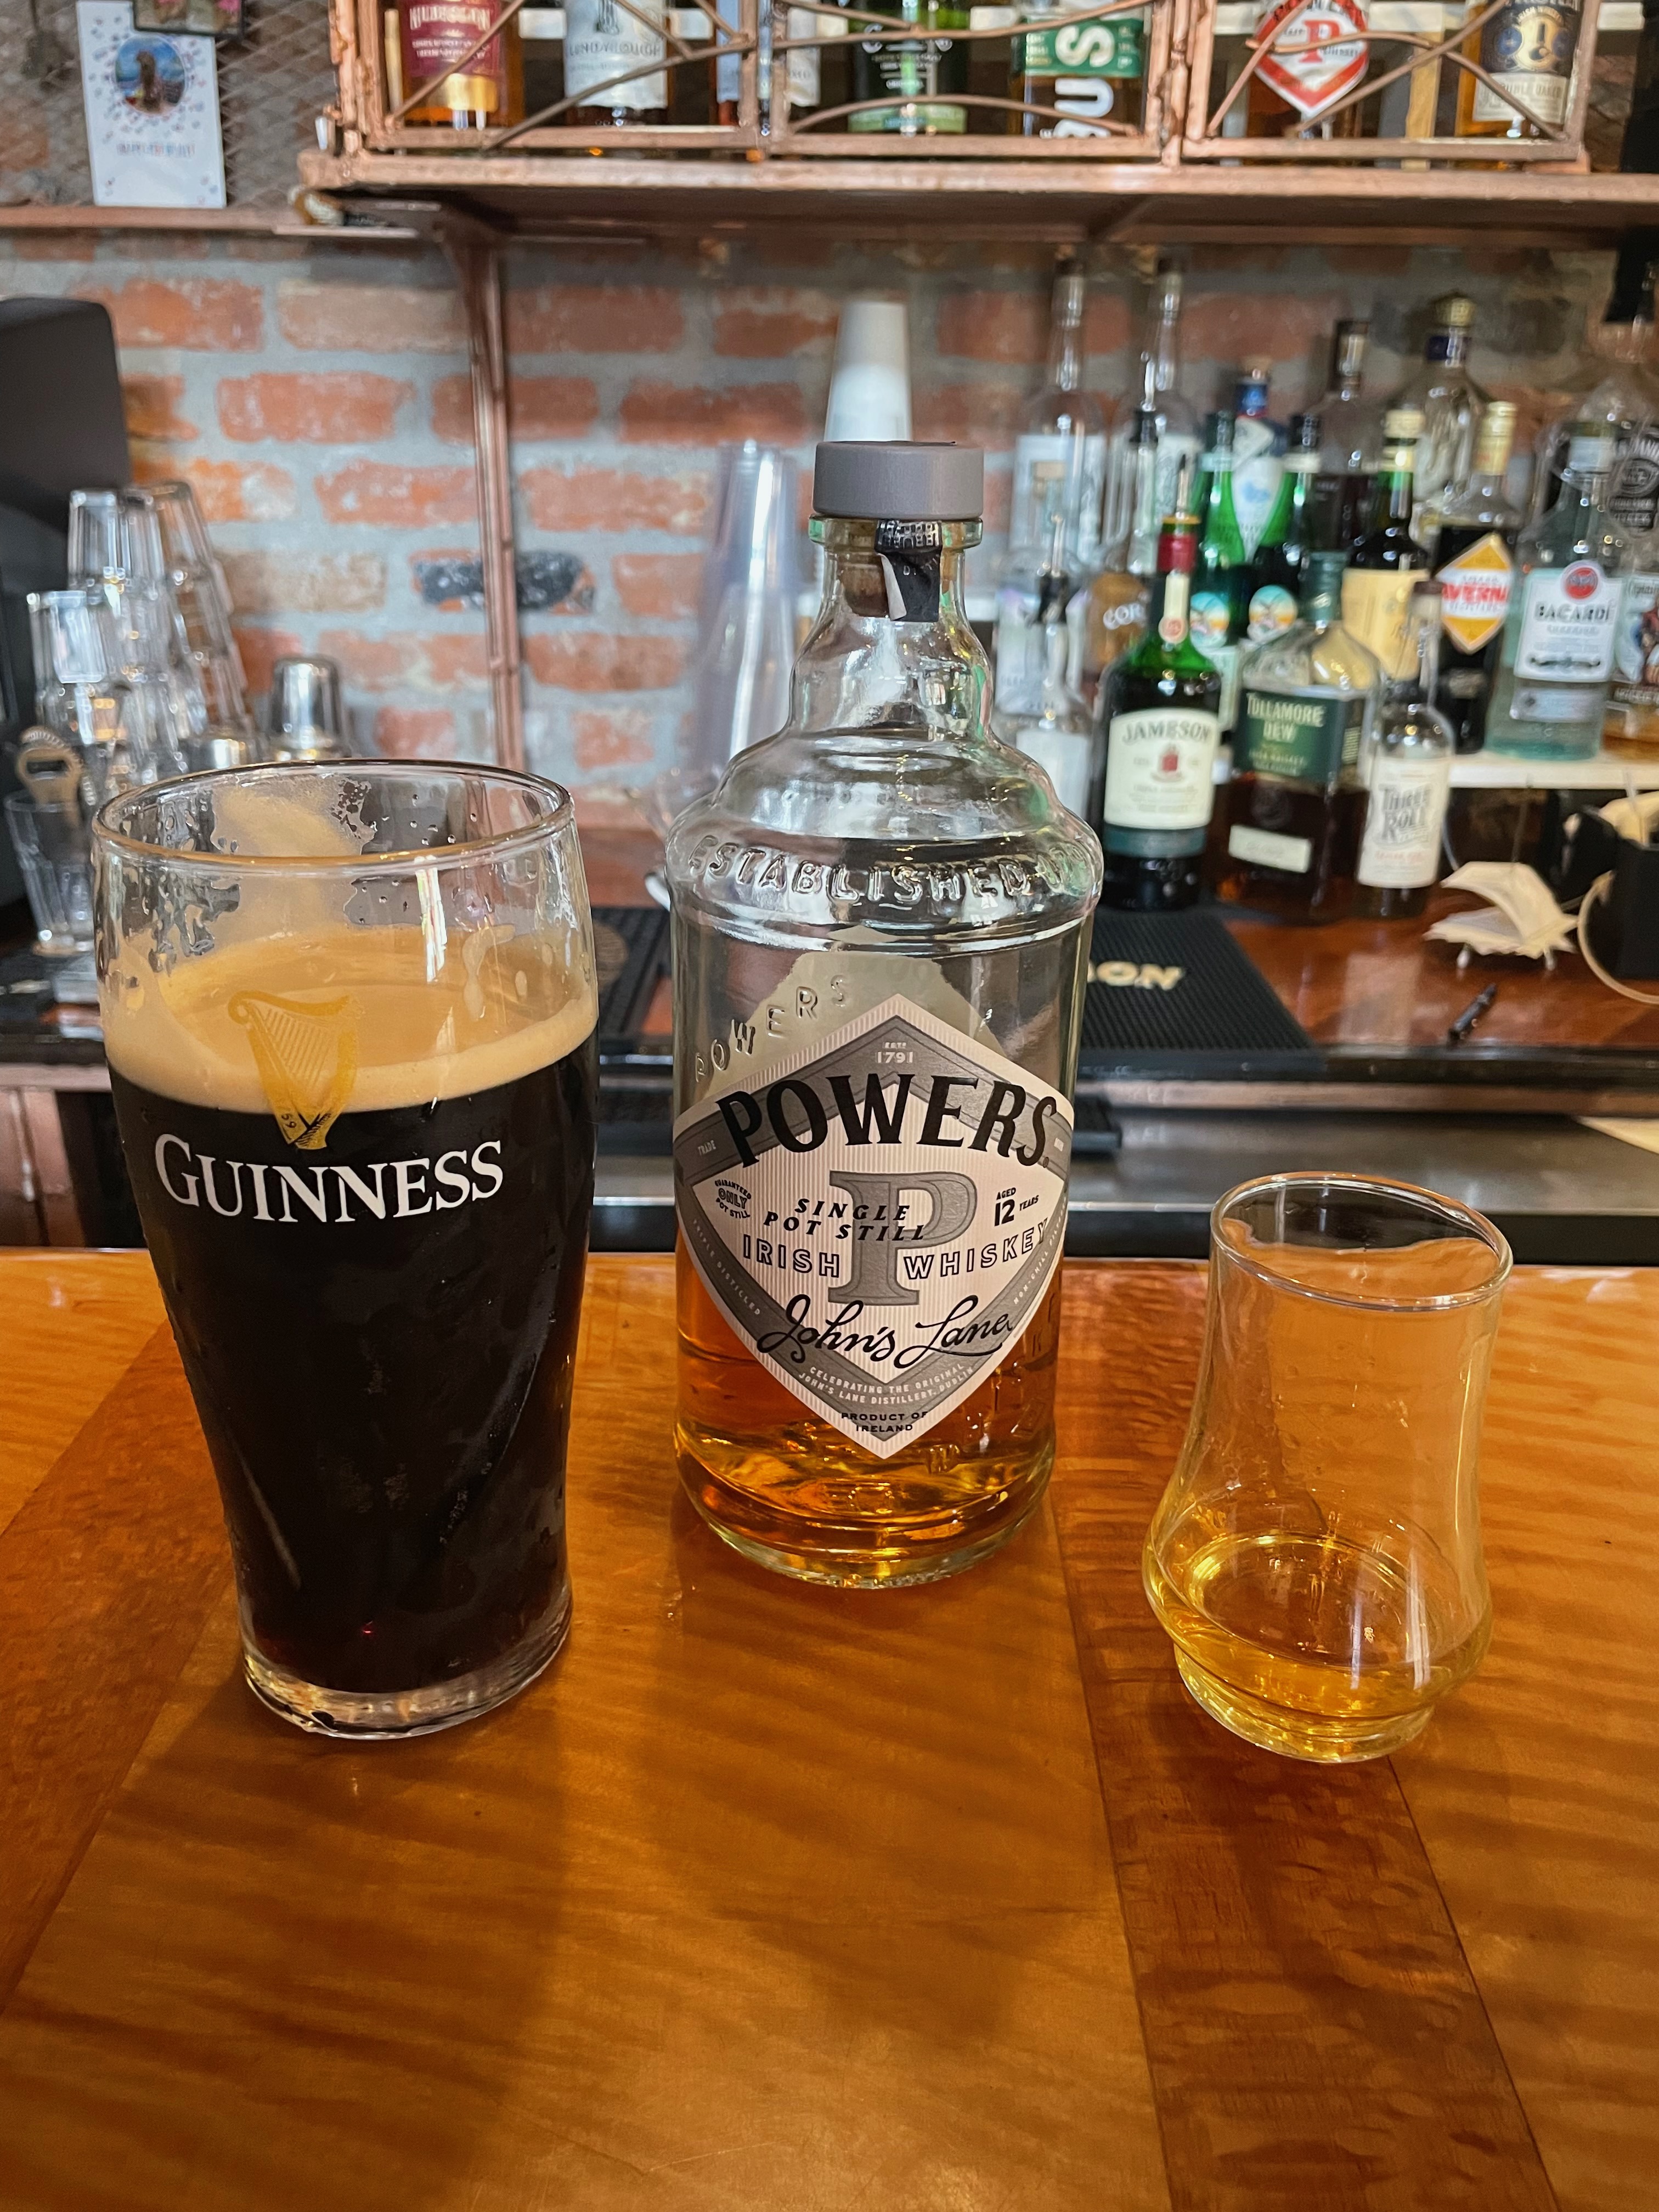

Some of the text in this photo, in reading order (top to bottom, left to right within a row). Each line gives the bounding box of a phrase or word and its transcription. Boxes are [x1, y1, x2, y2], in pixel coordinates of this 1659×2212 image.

[1246, 692, 1326, 727] TULLAMORE
[1122, 720, 1211, 746] JAMESON
[1263, 720, 1298, 743] DEW
[688, 834, 1032, 904] ESTABLISHED
[693, 974, 847, 1084] POWERS
[876, 1051, 914, 1064] 1791
[697, 1139, 717, 1156] TRADE
[154, 1132, 505, 1223] GUINNESS
[714, 1179, 752, 1200] GUARANTEED
[715, 1197, 751, 1219] POT STILL
[718, 1187, 748, 1209] ONLY
[996, 1187, 1017, 1201] AGED
[794, 1198, 910, 1221] SINGLE
[994, 1194, 1040, 1227] 12 YEARS
[763, 1211, 924, 1242] POT STILL
[743, 1217, 1048, 1280] IRISH WHISKEY
[1013, 1250, 1048, 1305] NON-CHILL
[755, 1293, 1013, 1369] John's Lane
[799, 1372, 834, 1395] JOHN'S
[838, 1390, 866, 1403] LANE
[939, 1367, 974, 1393] DUBLIN
[810, 1363, 964, 1394] CELEBRATING THE ORIGINAL
[840, 1410, 928, 1422] PRODUCT OF
[855, 1424, 913, 1433] IRELAND
